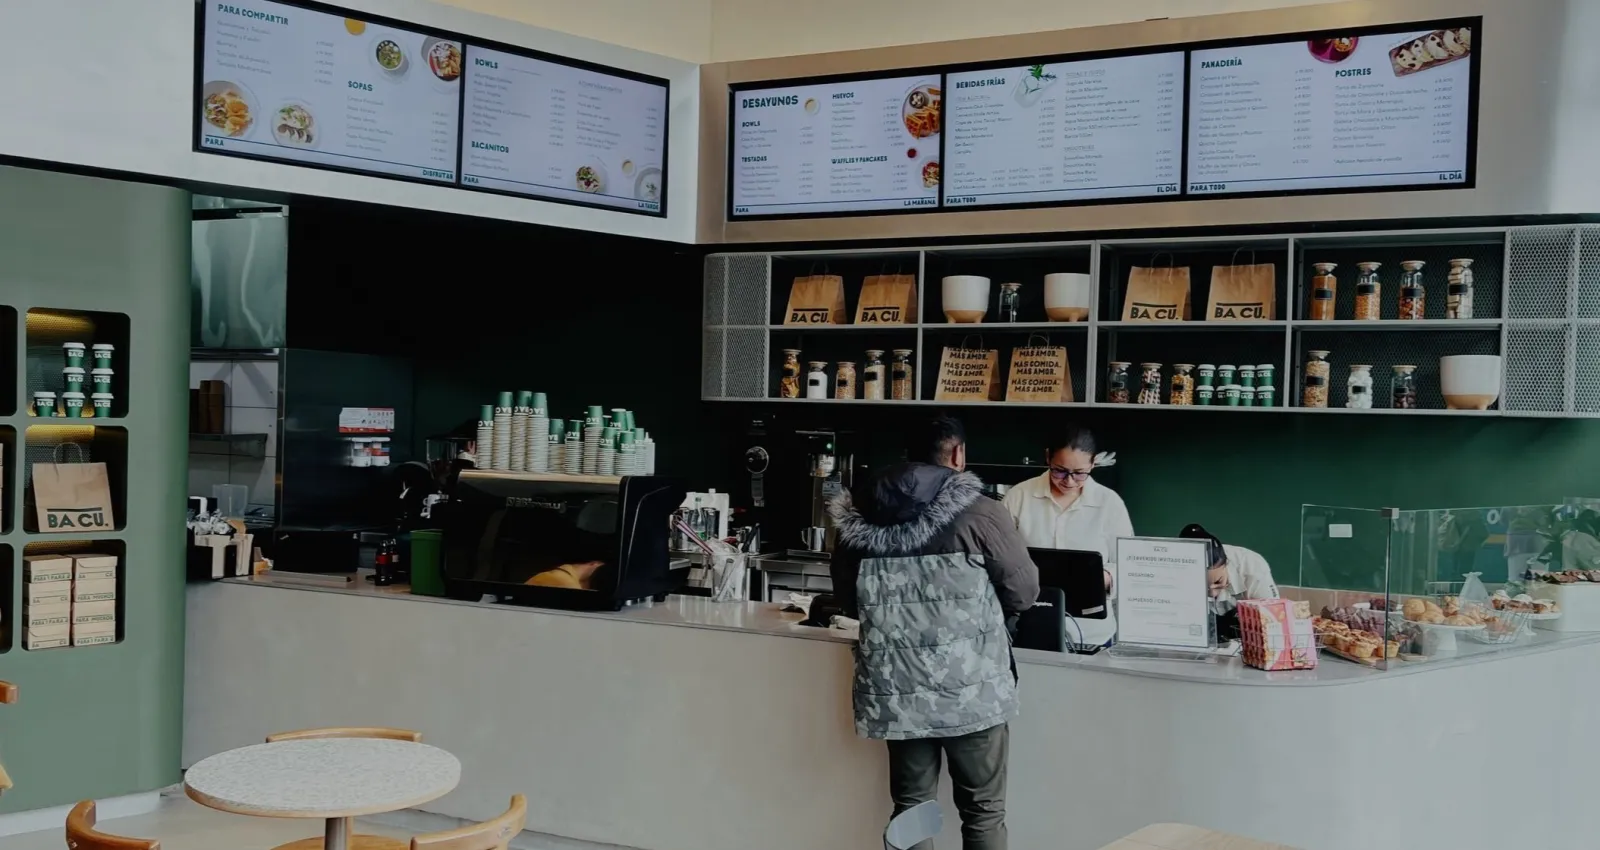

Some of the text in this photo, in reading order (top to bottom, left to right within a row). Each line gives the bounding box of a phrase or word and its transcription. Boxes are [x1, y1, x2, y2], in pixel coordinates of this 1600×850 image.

[218, 3, 289, 26] PARA COMPARTIR
[475, 58, 498, 70] BOWLS
[1201, 57, 1242, 68] PANADERÍA
[1335, 68, 1372, 77] POSTRES
[347, 80, 373, 92] SOPAS
[956, 77, 1006, 89] BEBIDAS FRÍAS
[742, 95, 799, 109] DESAYUNOS
[204, 138, 224, 147] PARA
[472, 140, 510, 154] BACANITOS
[422, 169, 454, 180] DISFRUTAR
[464, 176, 479, 184] PARA
[790, 312, 830, 324] BA CU.
[861, 310, 900, 322] BA CU.
[1130, 307, 1179, 320] BA CU.
[1214, 307, 1266, 319] BA CU.
[47, 513, 109, 528] BA CU.
